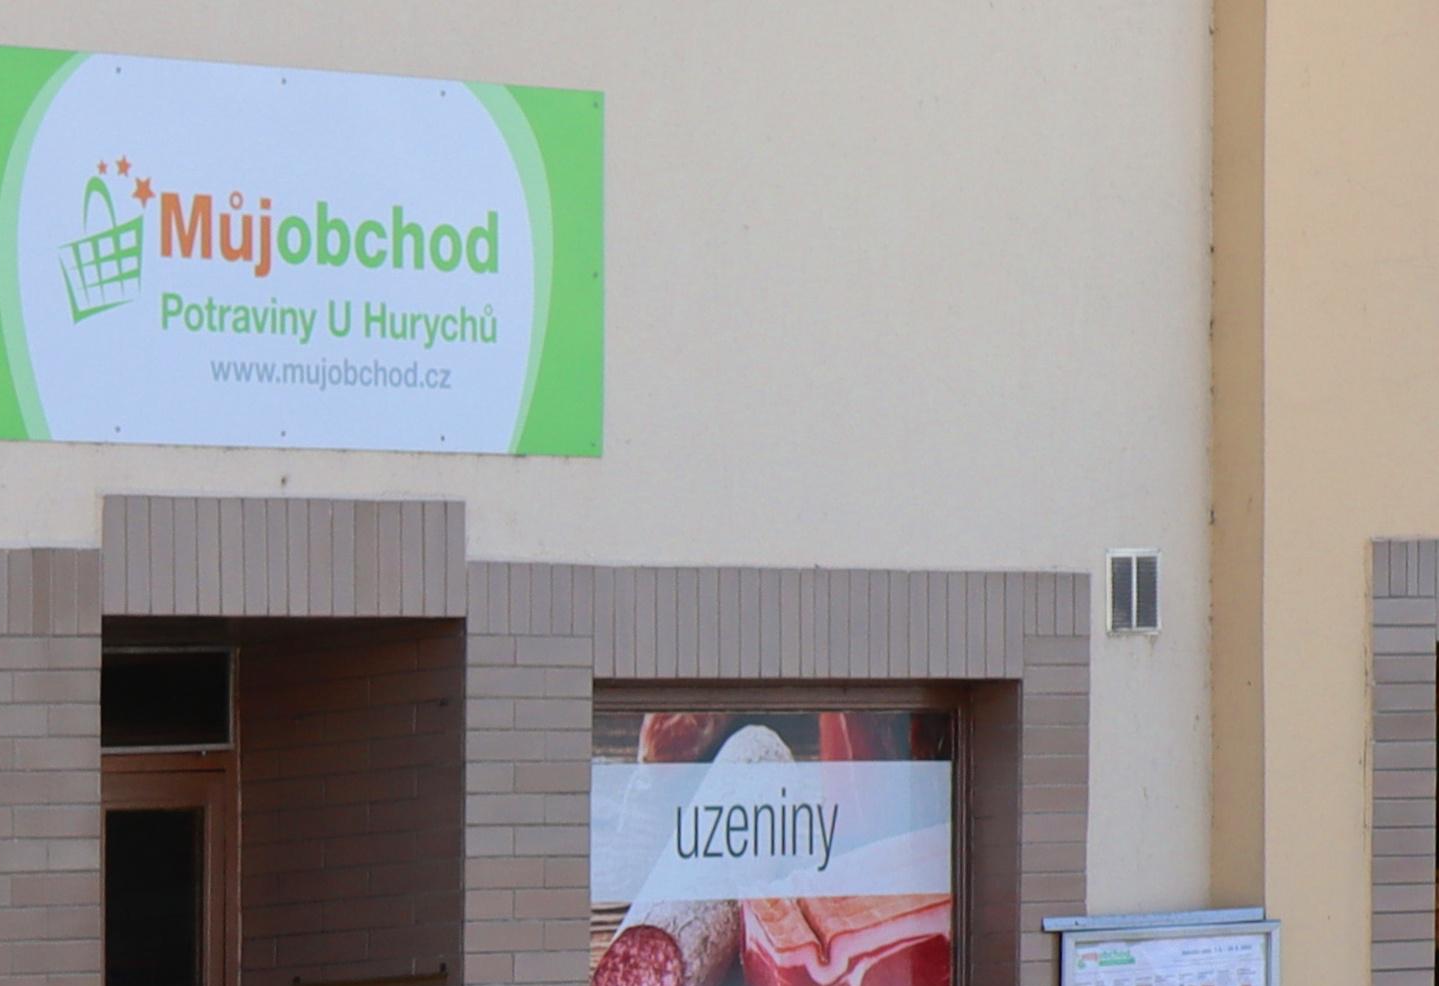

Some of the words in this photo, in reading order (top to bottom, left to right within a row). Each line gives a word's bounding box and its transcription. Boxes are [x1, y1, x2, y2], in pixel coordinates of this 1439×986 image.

[160, 190, 500, 279] Můjobchod
[161, 292, 317, 345] Potraviny
[328, 300, 353, 338] U
[364, 301, 498, 349] Hurychů
[209, 356, 452, 392] www.mujobchod.cz
[676, 787, 839, 872] uzeniny
